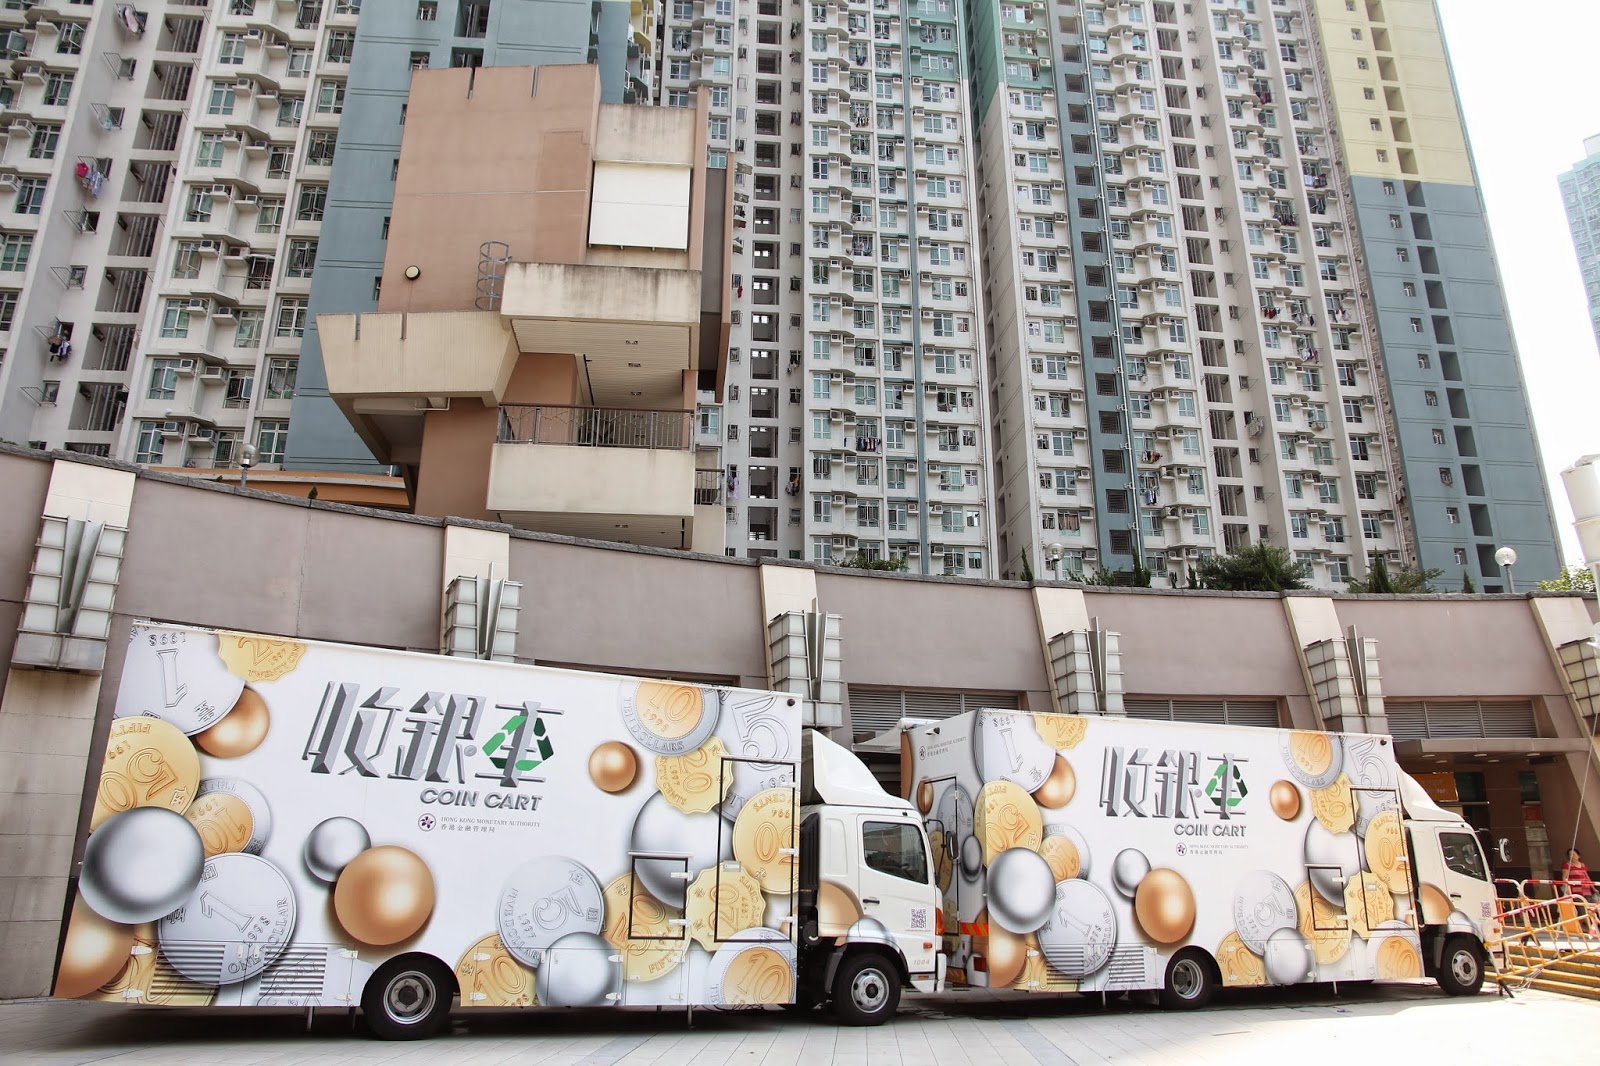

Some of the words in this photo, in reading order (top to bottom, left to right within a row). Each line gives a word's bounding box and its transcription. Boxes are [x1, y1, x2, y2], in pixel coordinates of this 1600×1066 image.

[420, 787, 479, 808] COIN
[484, 791, 543, 812] CART
[441, 823, 496, 833] 香港金融管理局
[476, 818, 508, 826] MONETARY
[508, 820, 541, 828] AUTHORITY
[1174, 823, 1209, 836] COIN
[1212, 824, 1247, 837] CART
